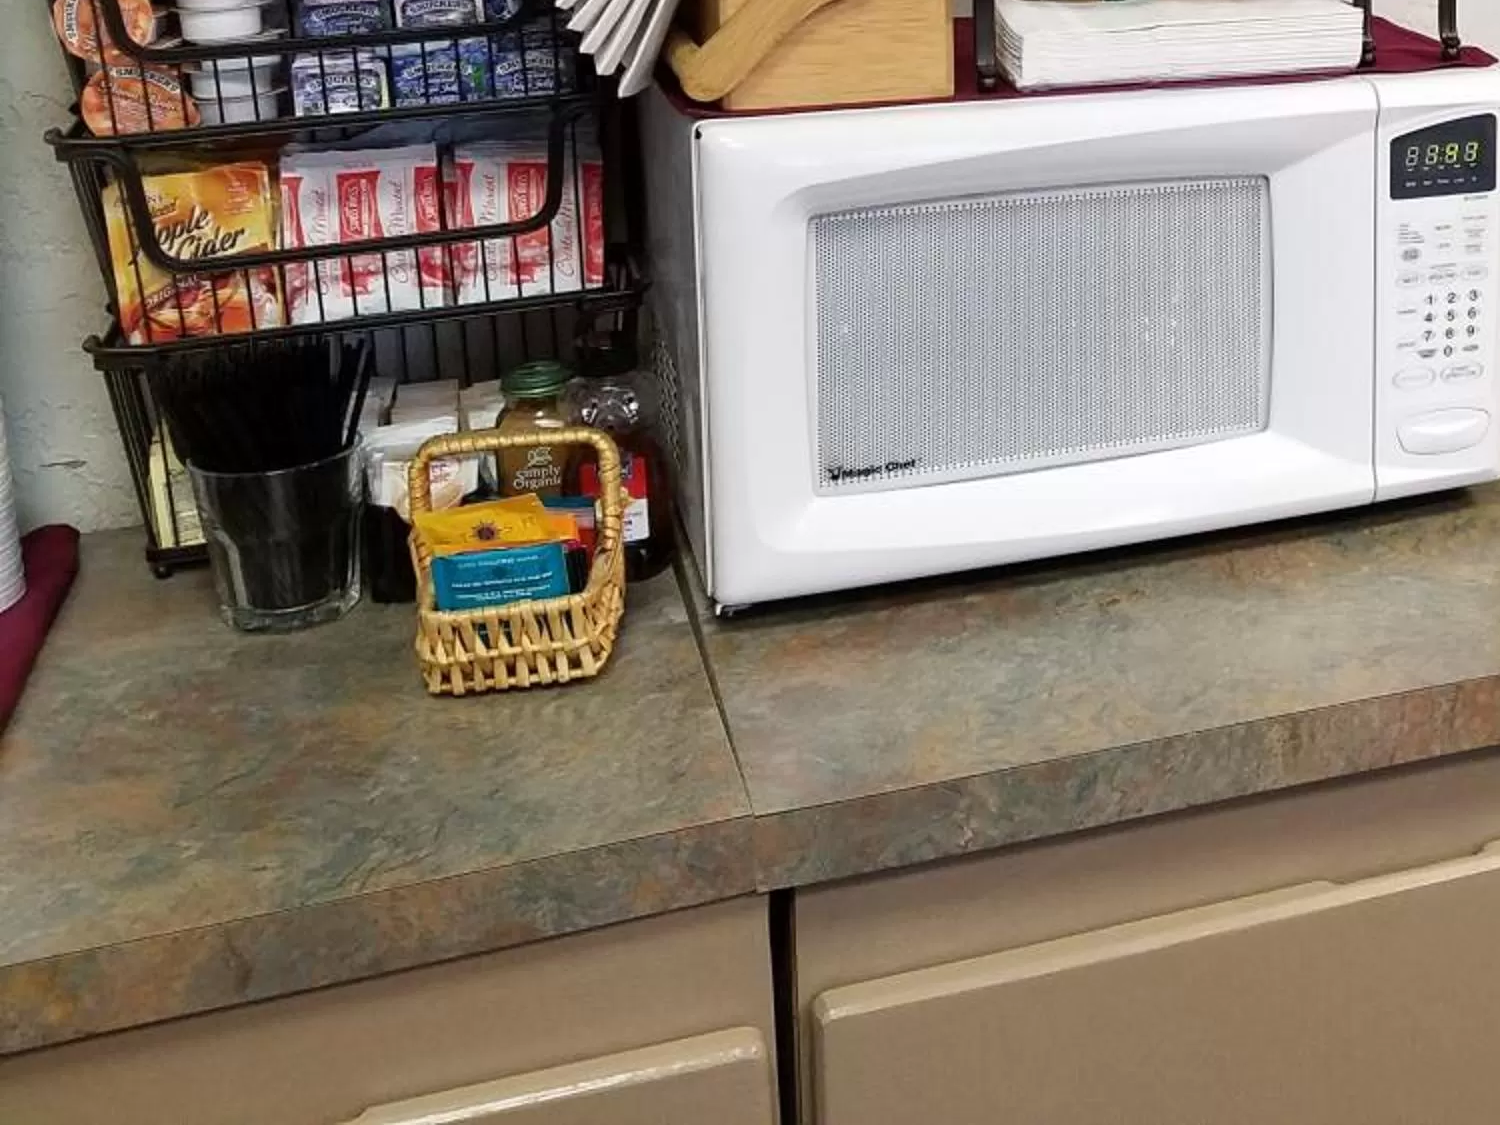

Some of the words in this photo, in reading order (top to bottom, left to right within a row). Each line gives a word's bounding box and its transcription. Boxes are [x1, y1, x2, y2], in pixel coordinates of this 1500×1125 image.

[153, 204, 212, 252] pple
[174, 228, 245, 260] Cider
[1447, 292, 1457, 304] 2
[1469, 288, 1478, 301] 3
[1424, 312, 1433, 322] 4
[1447, 309, 1455, 322] 5
[1467, 306, 1477, 319] 6
[1424, 330, 1432, 342] 7
[1445, 327, 1454, 339] 8
[1466, 324, 1475, 337] 9
[1443, 345, 1453, 357] 0
